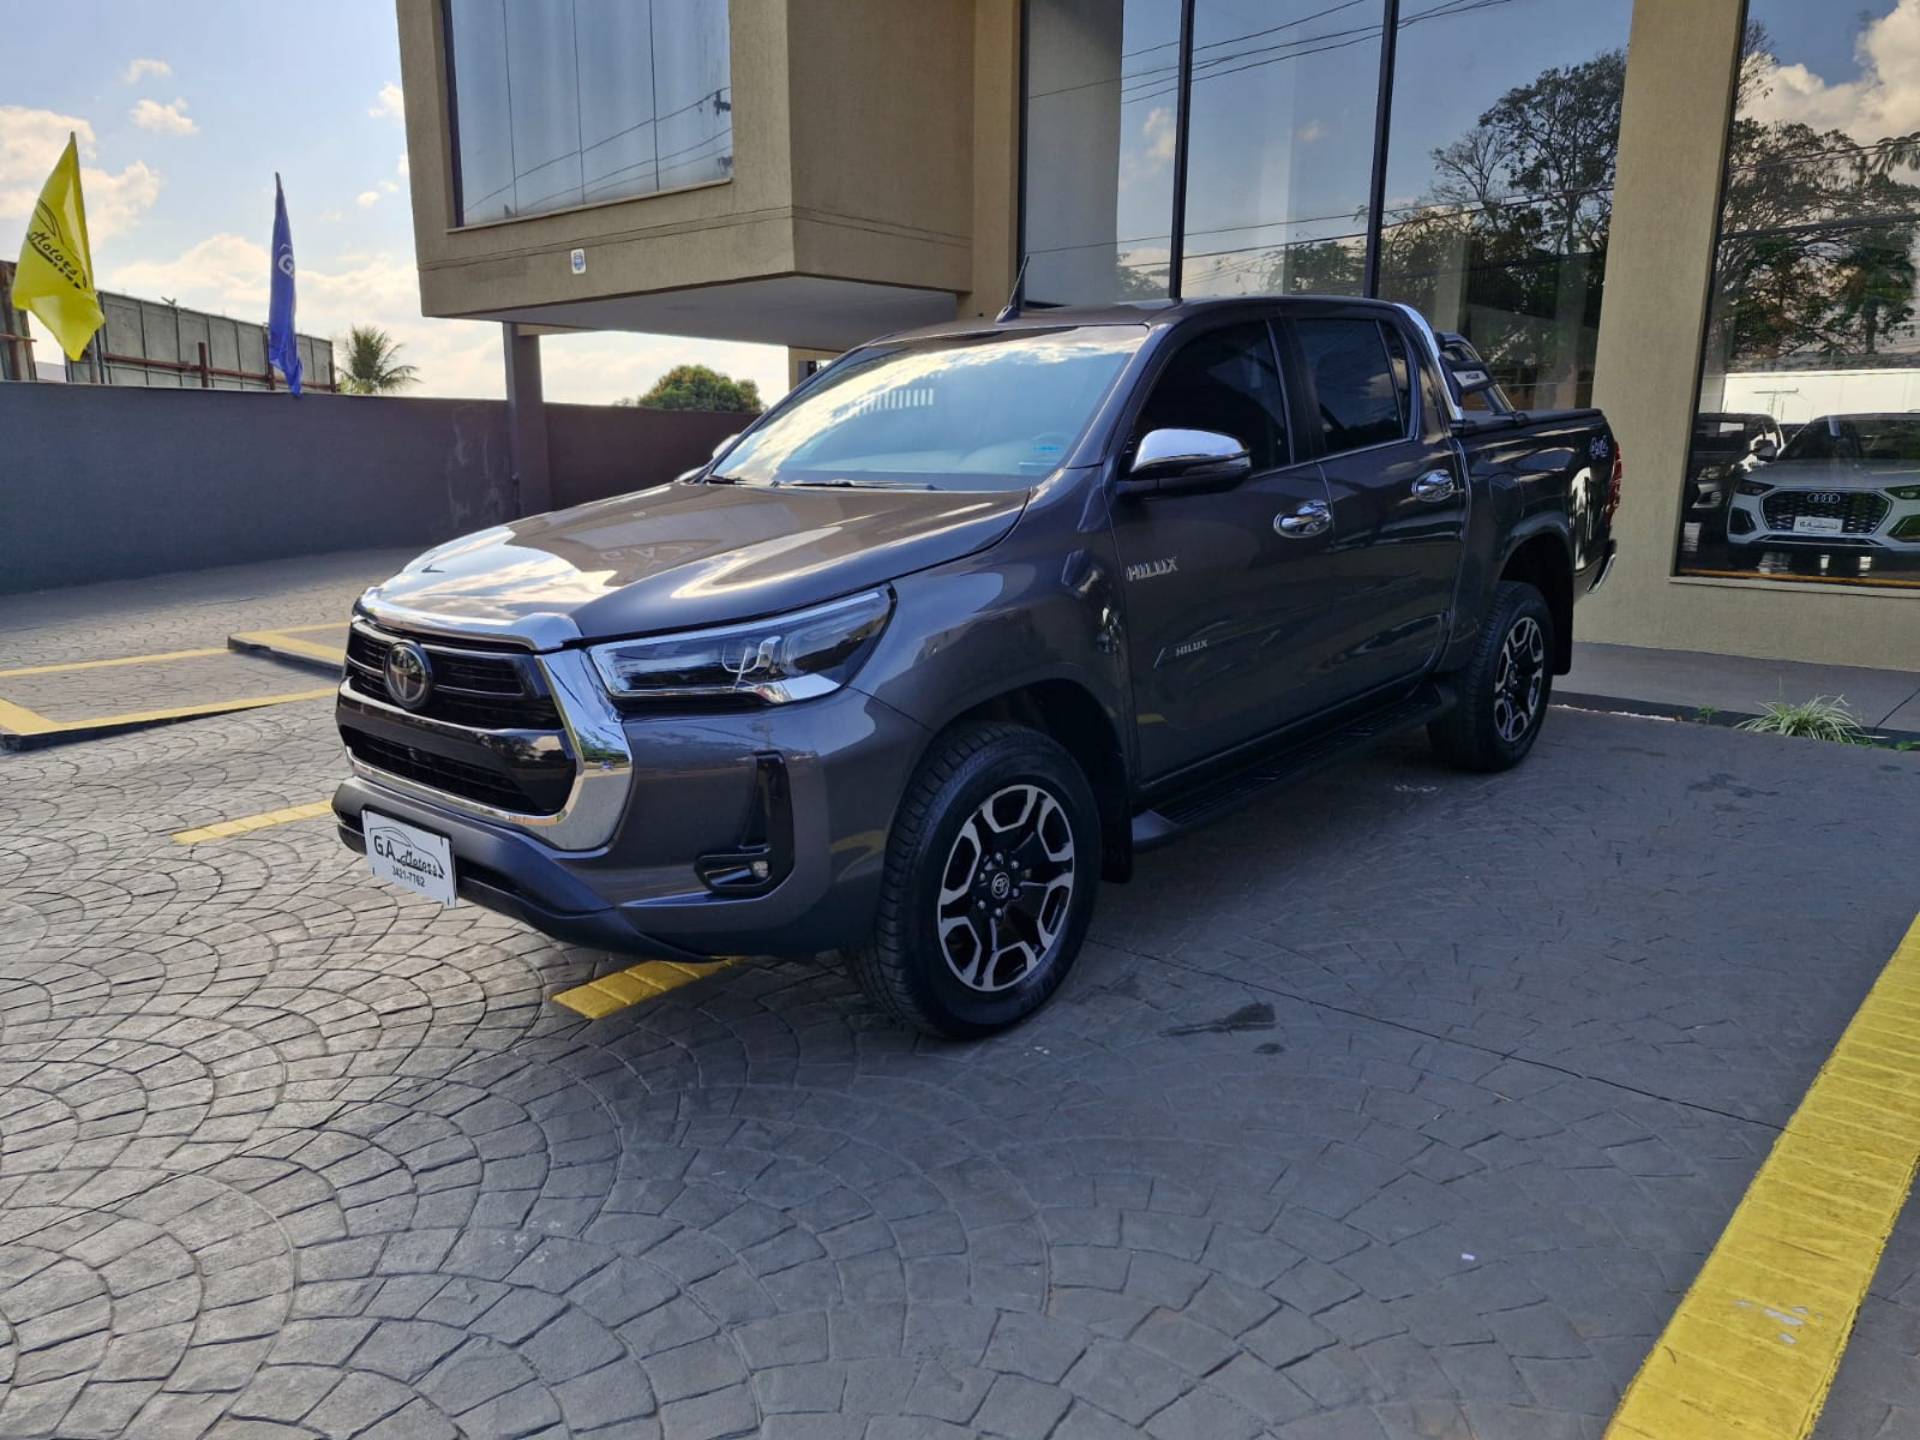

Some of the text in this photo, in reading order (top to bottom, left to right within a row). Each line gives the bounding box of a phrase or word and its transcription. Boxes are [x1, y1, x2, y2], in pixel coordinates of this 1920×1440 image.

[1127, 556, 1178, 582] HILUX
[1175, 639, 1208, 657] HILUX
[373, 835, 396, 861] GA
